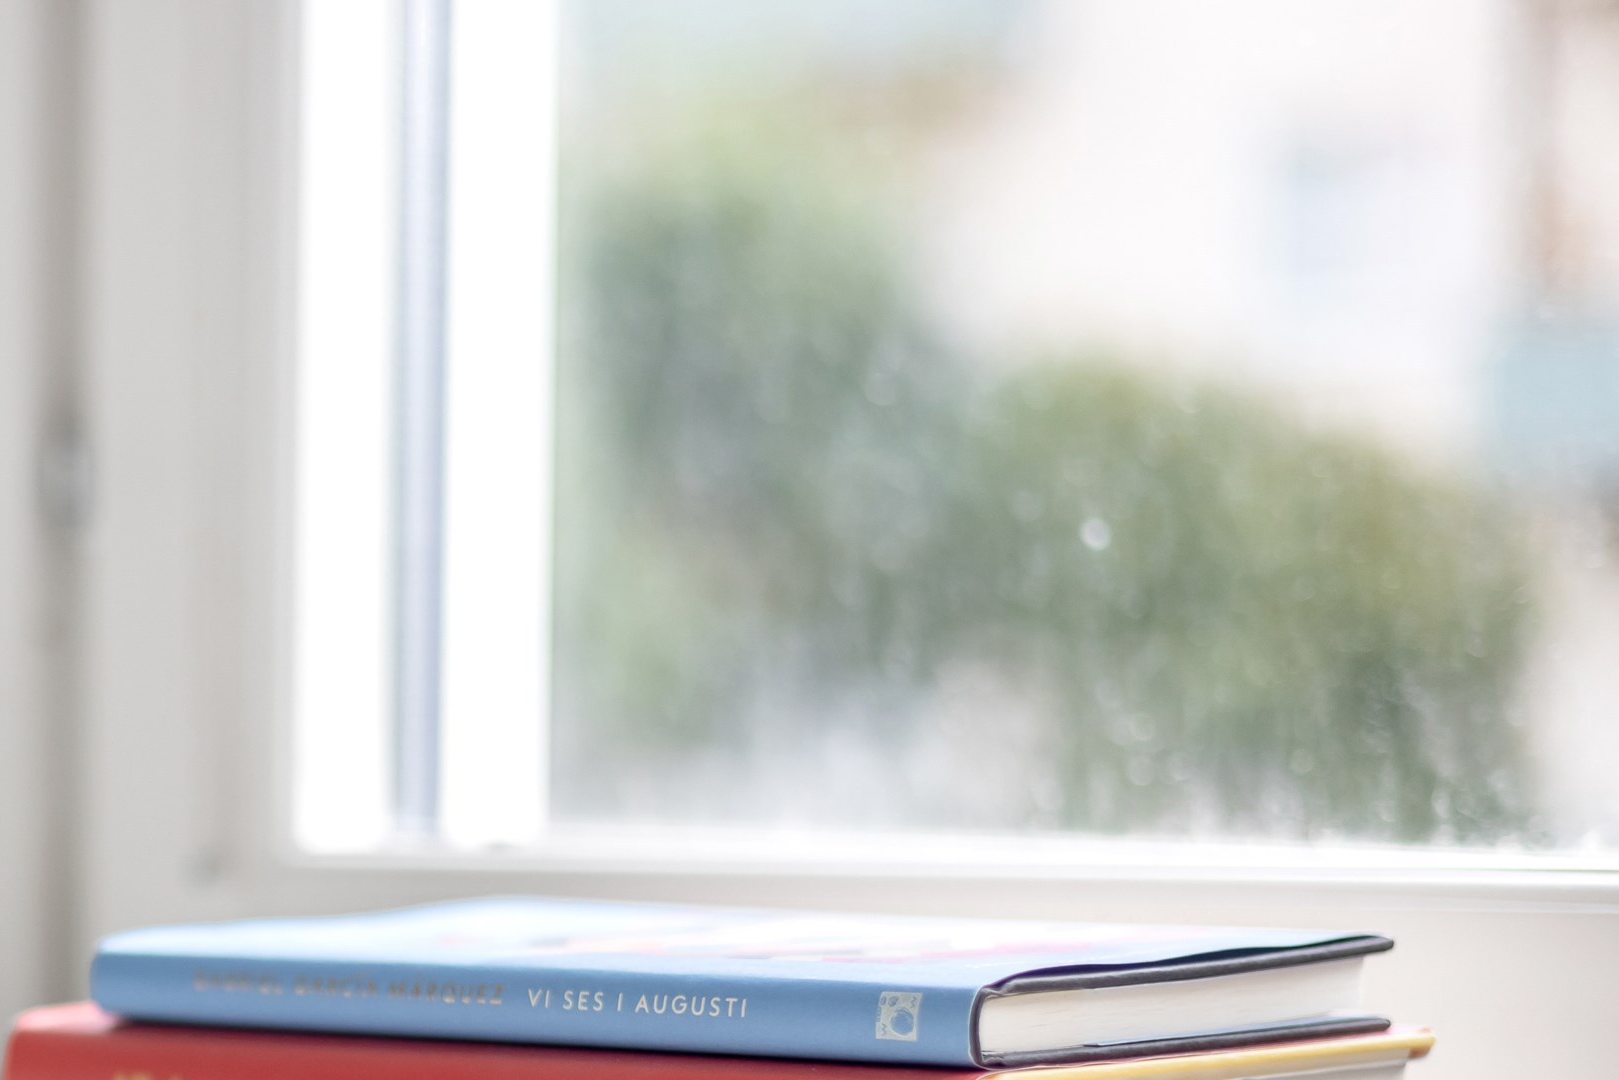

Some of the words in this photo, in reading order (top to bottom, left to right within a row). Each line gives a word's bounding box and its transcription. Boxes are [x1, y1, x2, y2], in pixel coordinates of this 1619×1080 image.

[527, 988, 550, 1009] VI
[562, 989, 604, 1012] SES
[616, 992, 623, 1013] I
[634, 994, 748, 1019] AUGUSTI
